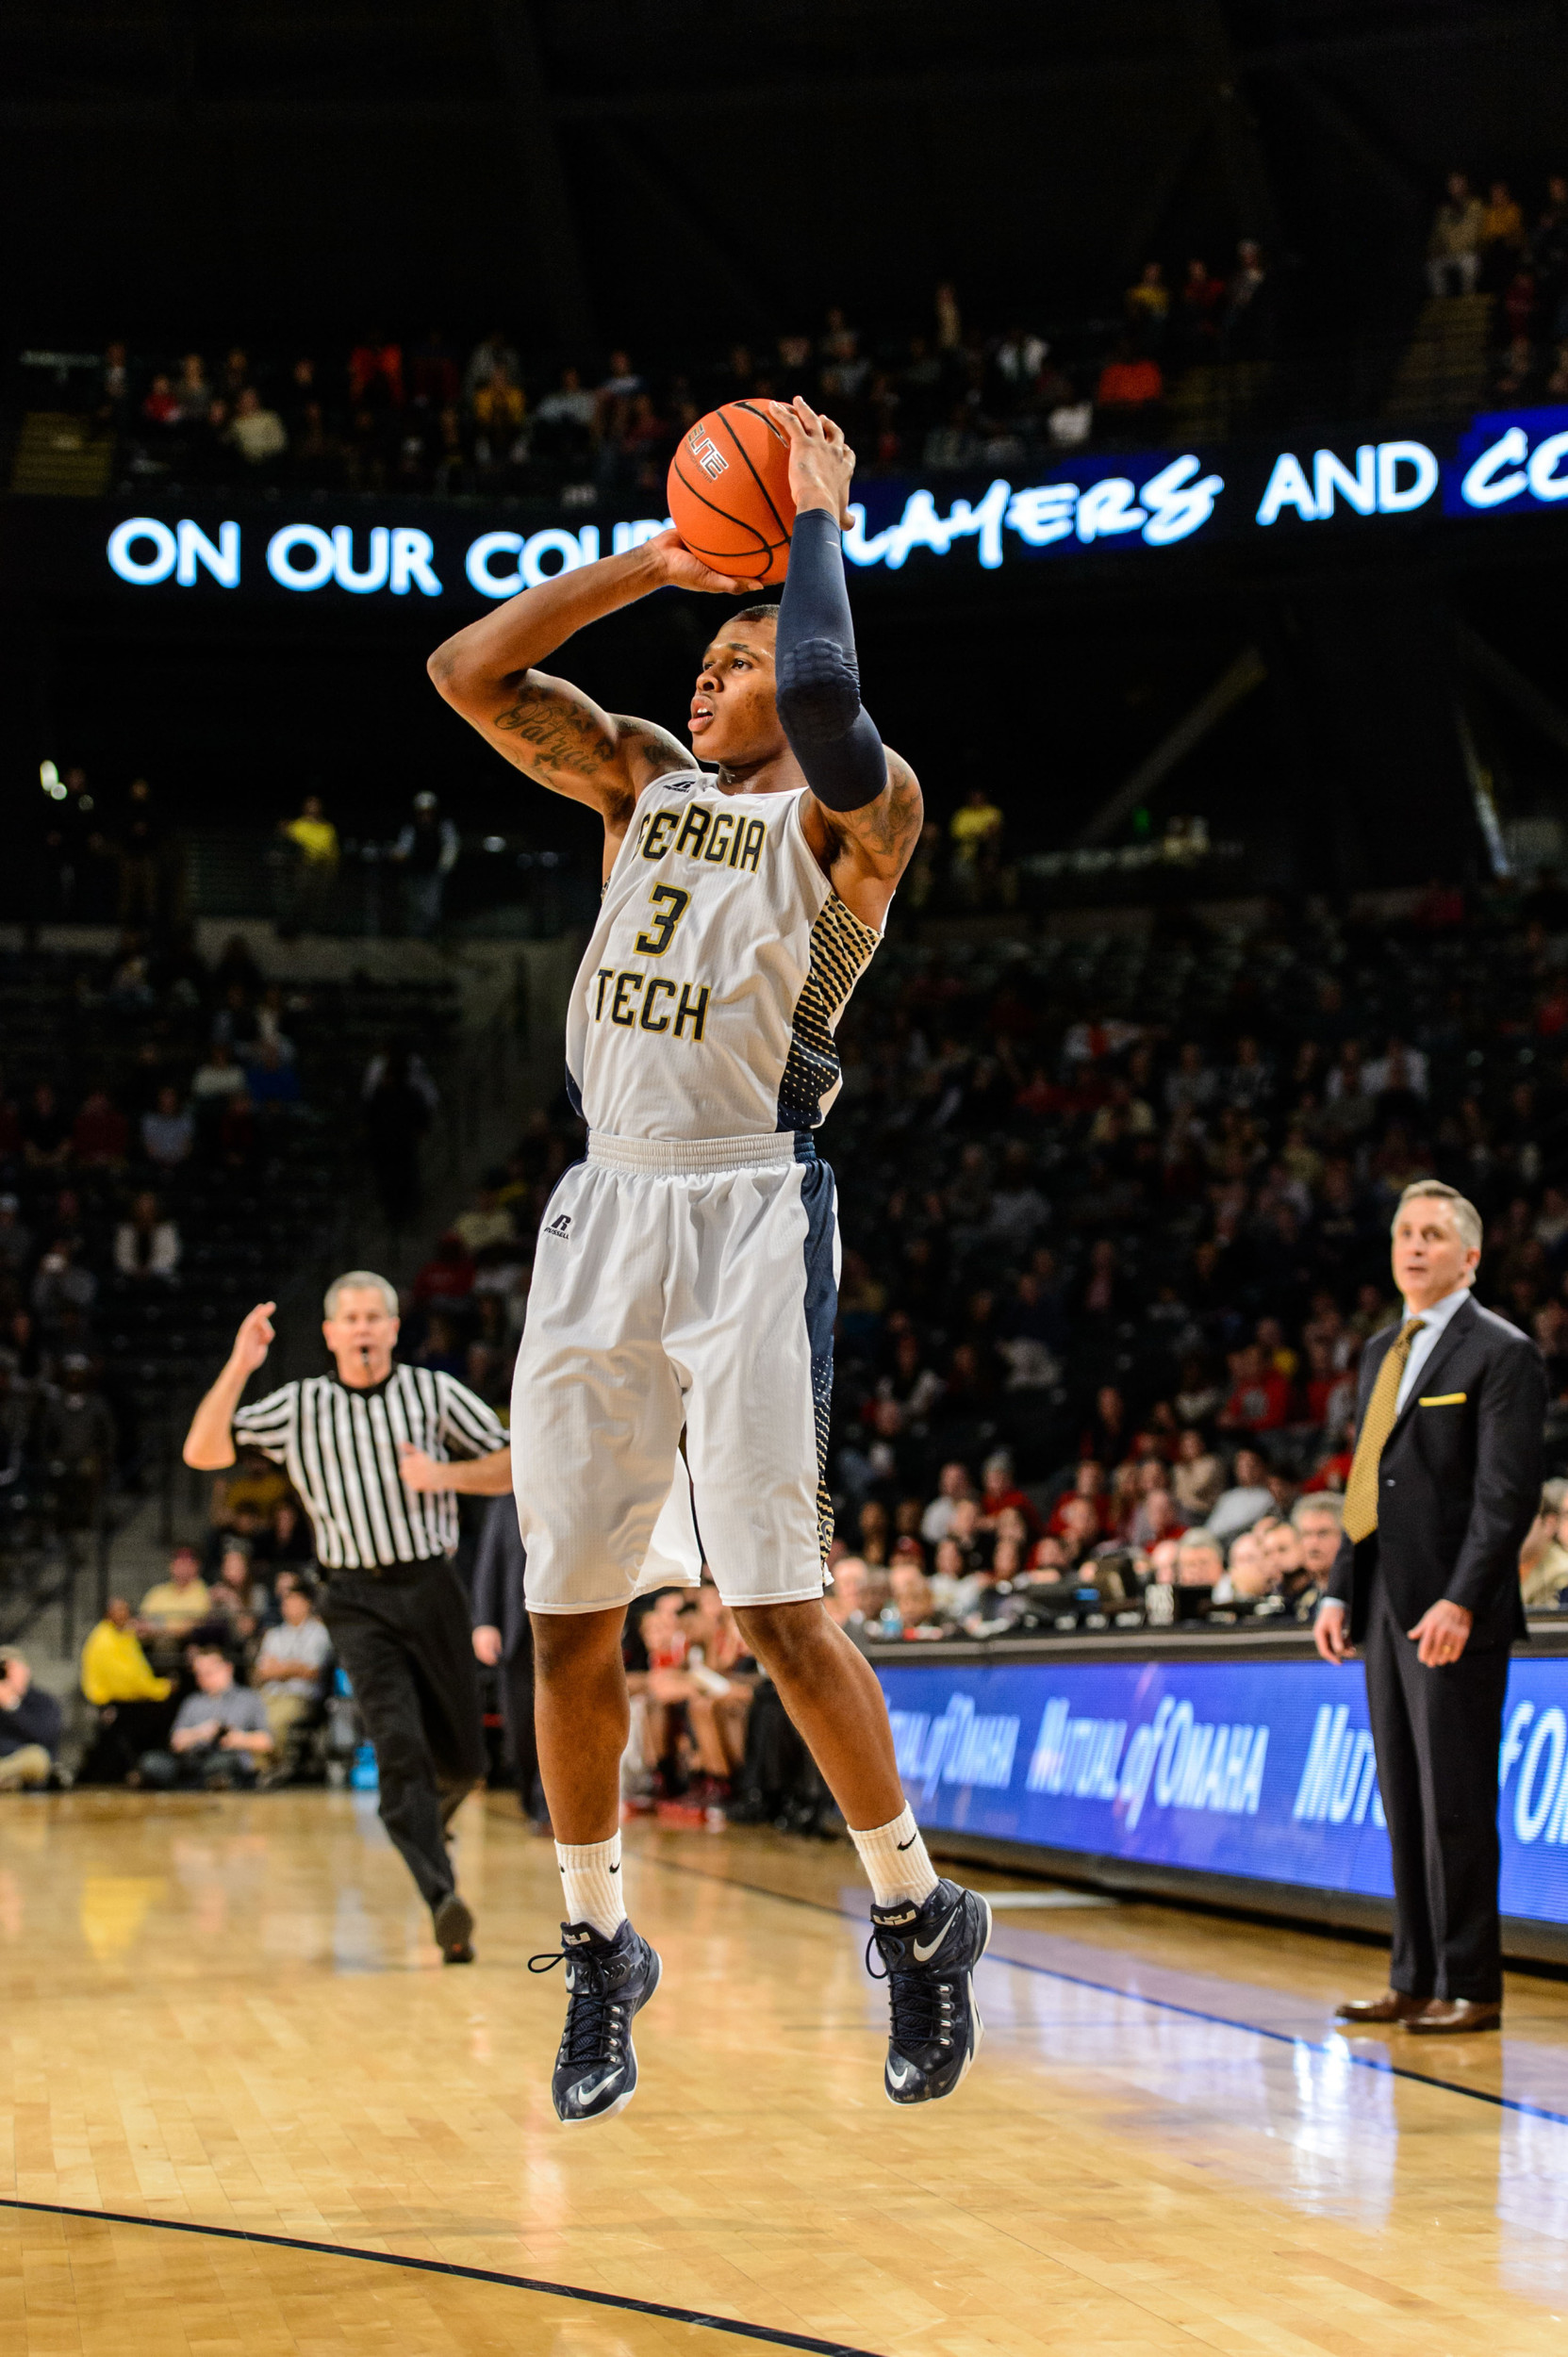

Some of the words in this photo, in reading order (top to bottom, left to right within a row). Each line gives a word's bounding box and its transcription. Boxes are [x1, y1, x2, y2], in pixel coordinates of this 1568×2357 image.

[687, 422, 729, 480] ELITE
[107, 516, 241, 588] ON
[267, 522, 443, 597] OUR
[465, 518, 676, 600] COU
[842, 453, 1224, 570] LAYERS
[1255, 439, 1439, 526] AND
[633, 882, 691, 958] 3
[595, 966, 711, 1044] TECH
[543, 1227, 569, 1241] RUSSELL
